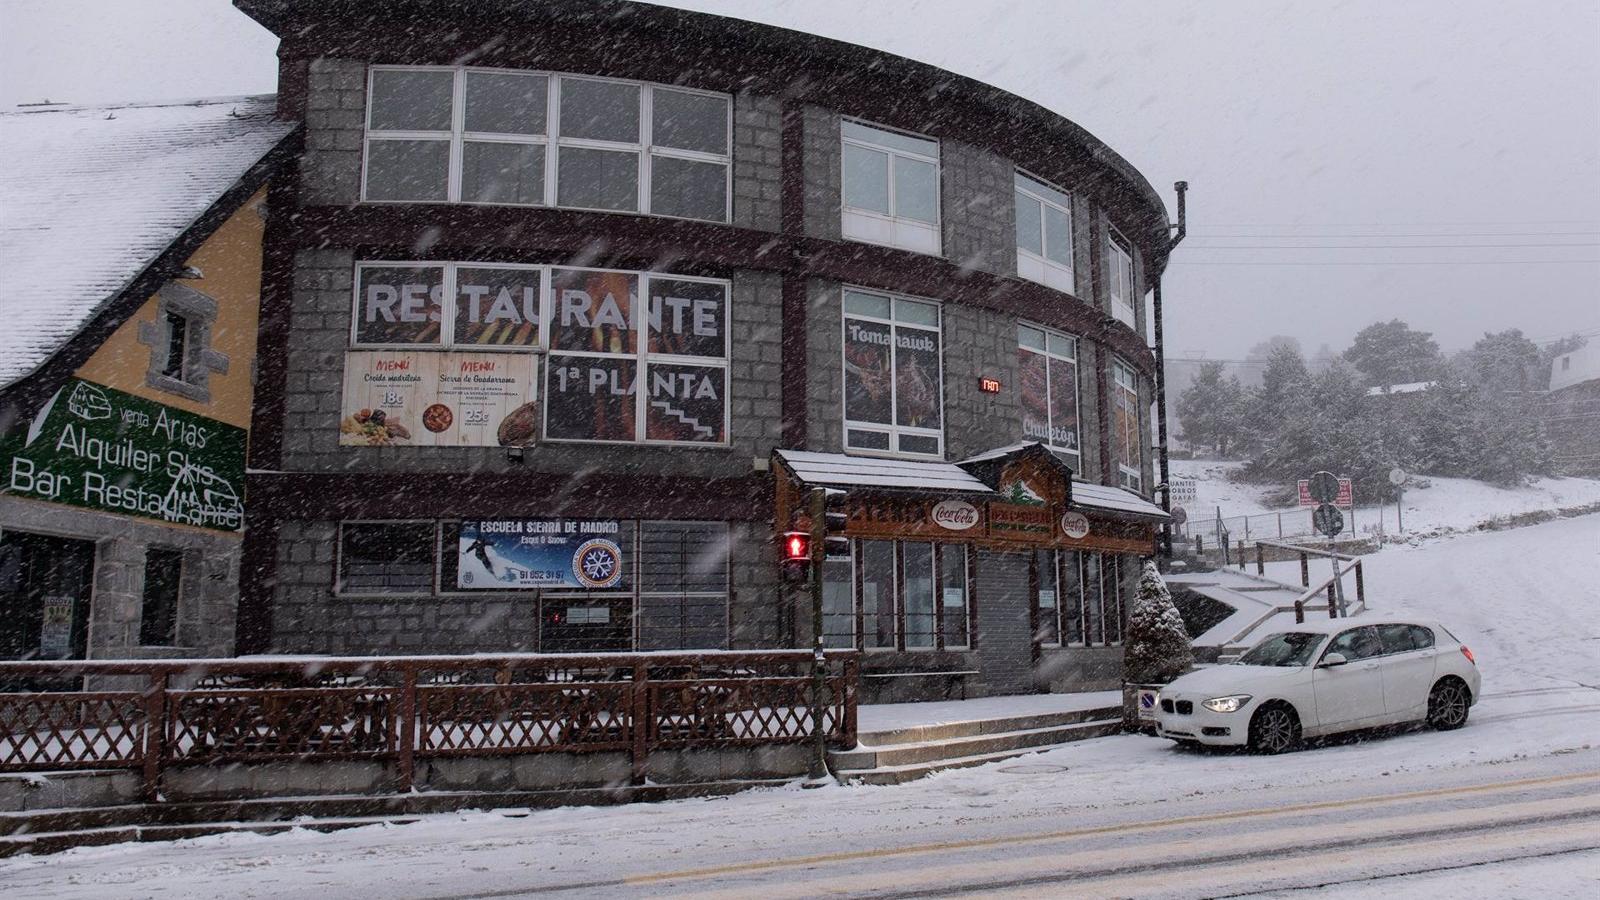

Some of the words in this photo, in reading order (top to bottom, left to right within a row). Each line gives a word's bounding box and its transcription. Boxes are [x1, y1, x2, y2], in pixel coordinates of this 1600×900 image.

[366, 284, 718, 337] RESTAURANTE
[589, 368, 718, 400] PLANTA
[120, 407, 150, 428] venta
[152, 407, 206, 449] Arias
[56, 423, 161, 472] Alquiler
[167, 450, 214, 486] Skis
[11, 456, 71, 498] Bar
[84, 471, 240, 529] Restaurante
[480, 521, 523, 533] ESCUELA
[526, 521, 561, 533] SIERRA
[565, 521, 577, 533] DE
[580, 521, 618, 533] MADRID
[936, 506, 974, 523] Coca-Cola
